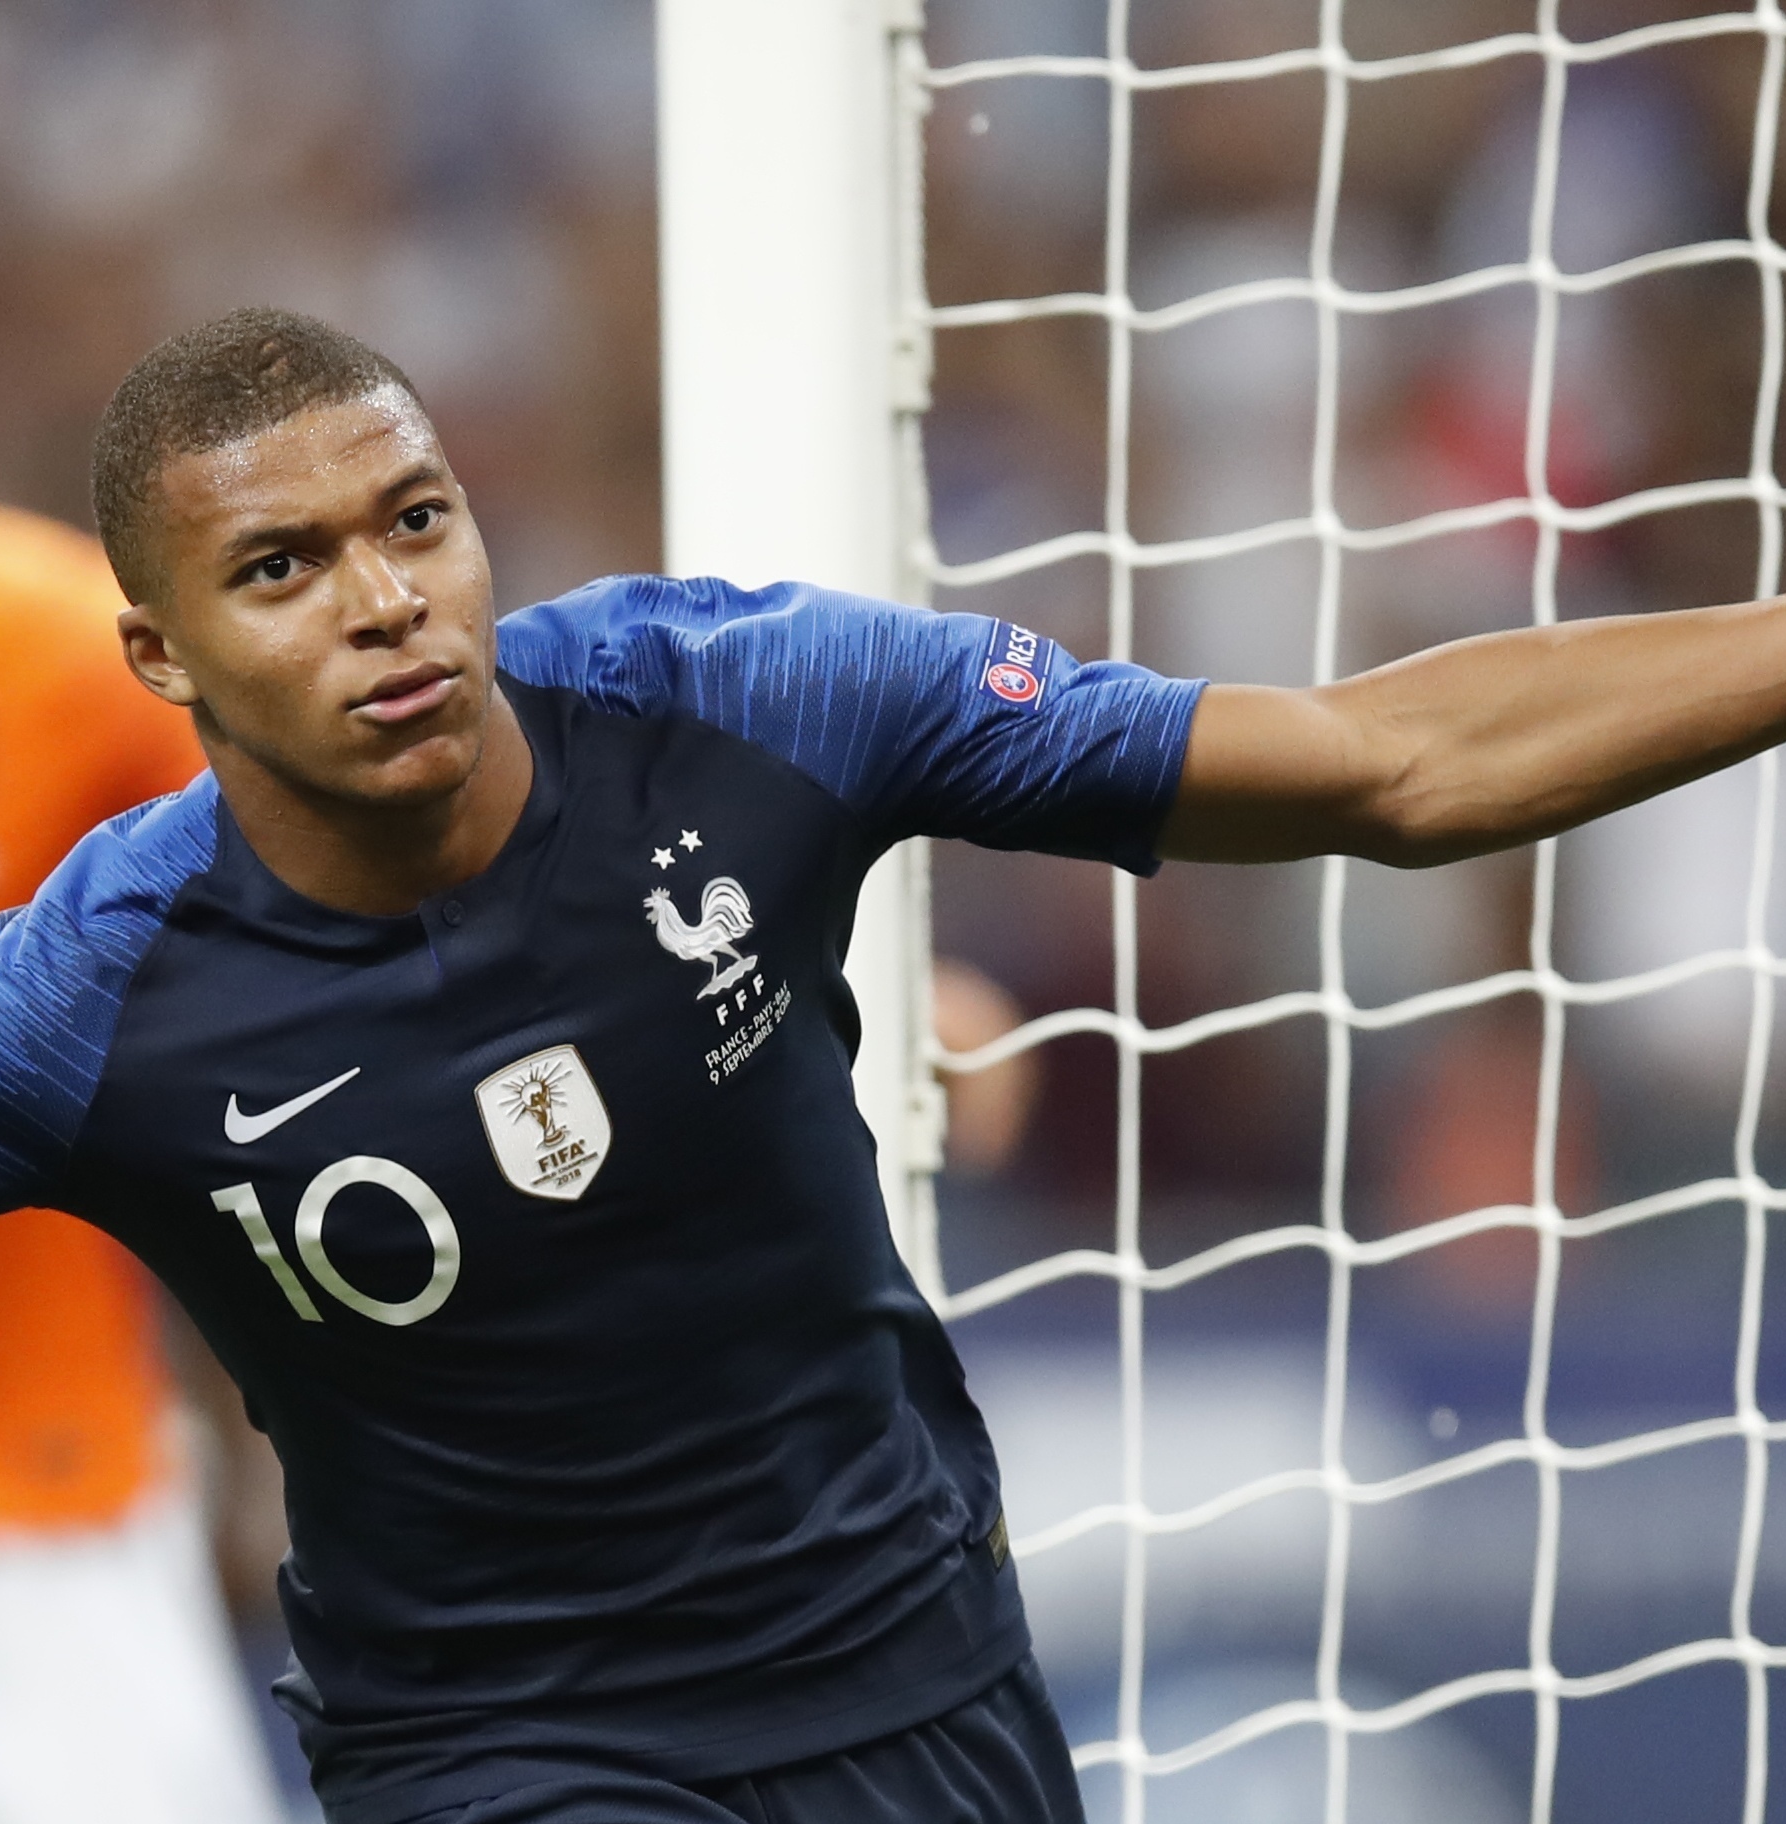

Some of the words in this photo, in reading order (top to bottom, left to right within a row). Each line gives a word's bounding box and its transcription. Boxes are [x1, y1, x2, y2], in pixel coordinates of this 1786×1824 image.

[704, 1026, 749, 1069] FRANCE
[709, 1069, 720, 1086] 9
[722, 1018, 775, 1077] SEPTEMBRE
[538, 1142, 585, 1174] FIFA
[555, 1168, 582, 1186] 2018
[209, 1154, 462, 1327] 10
